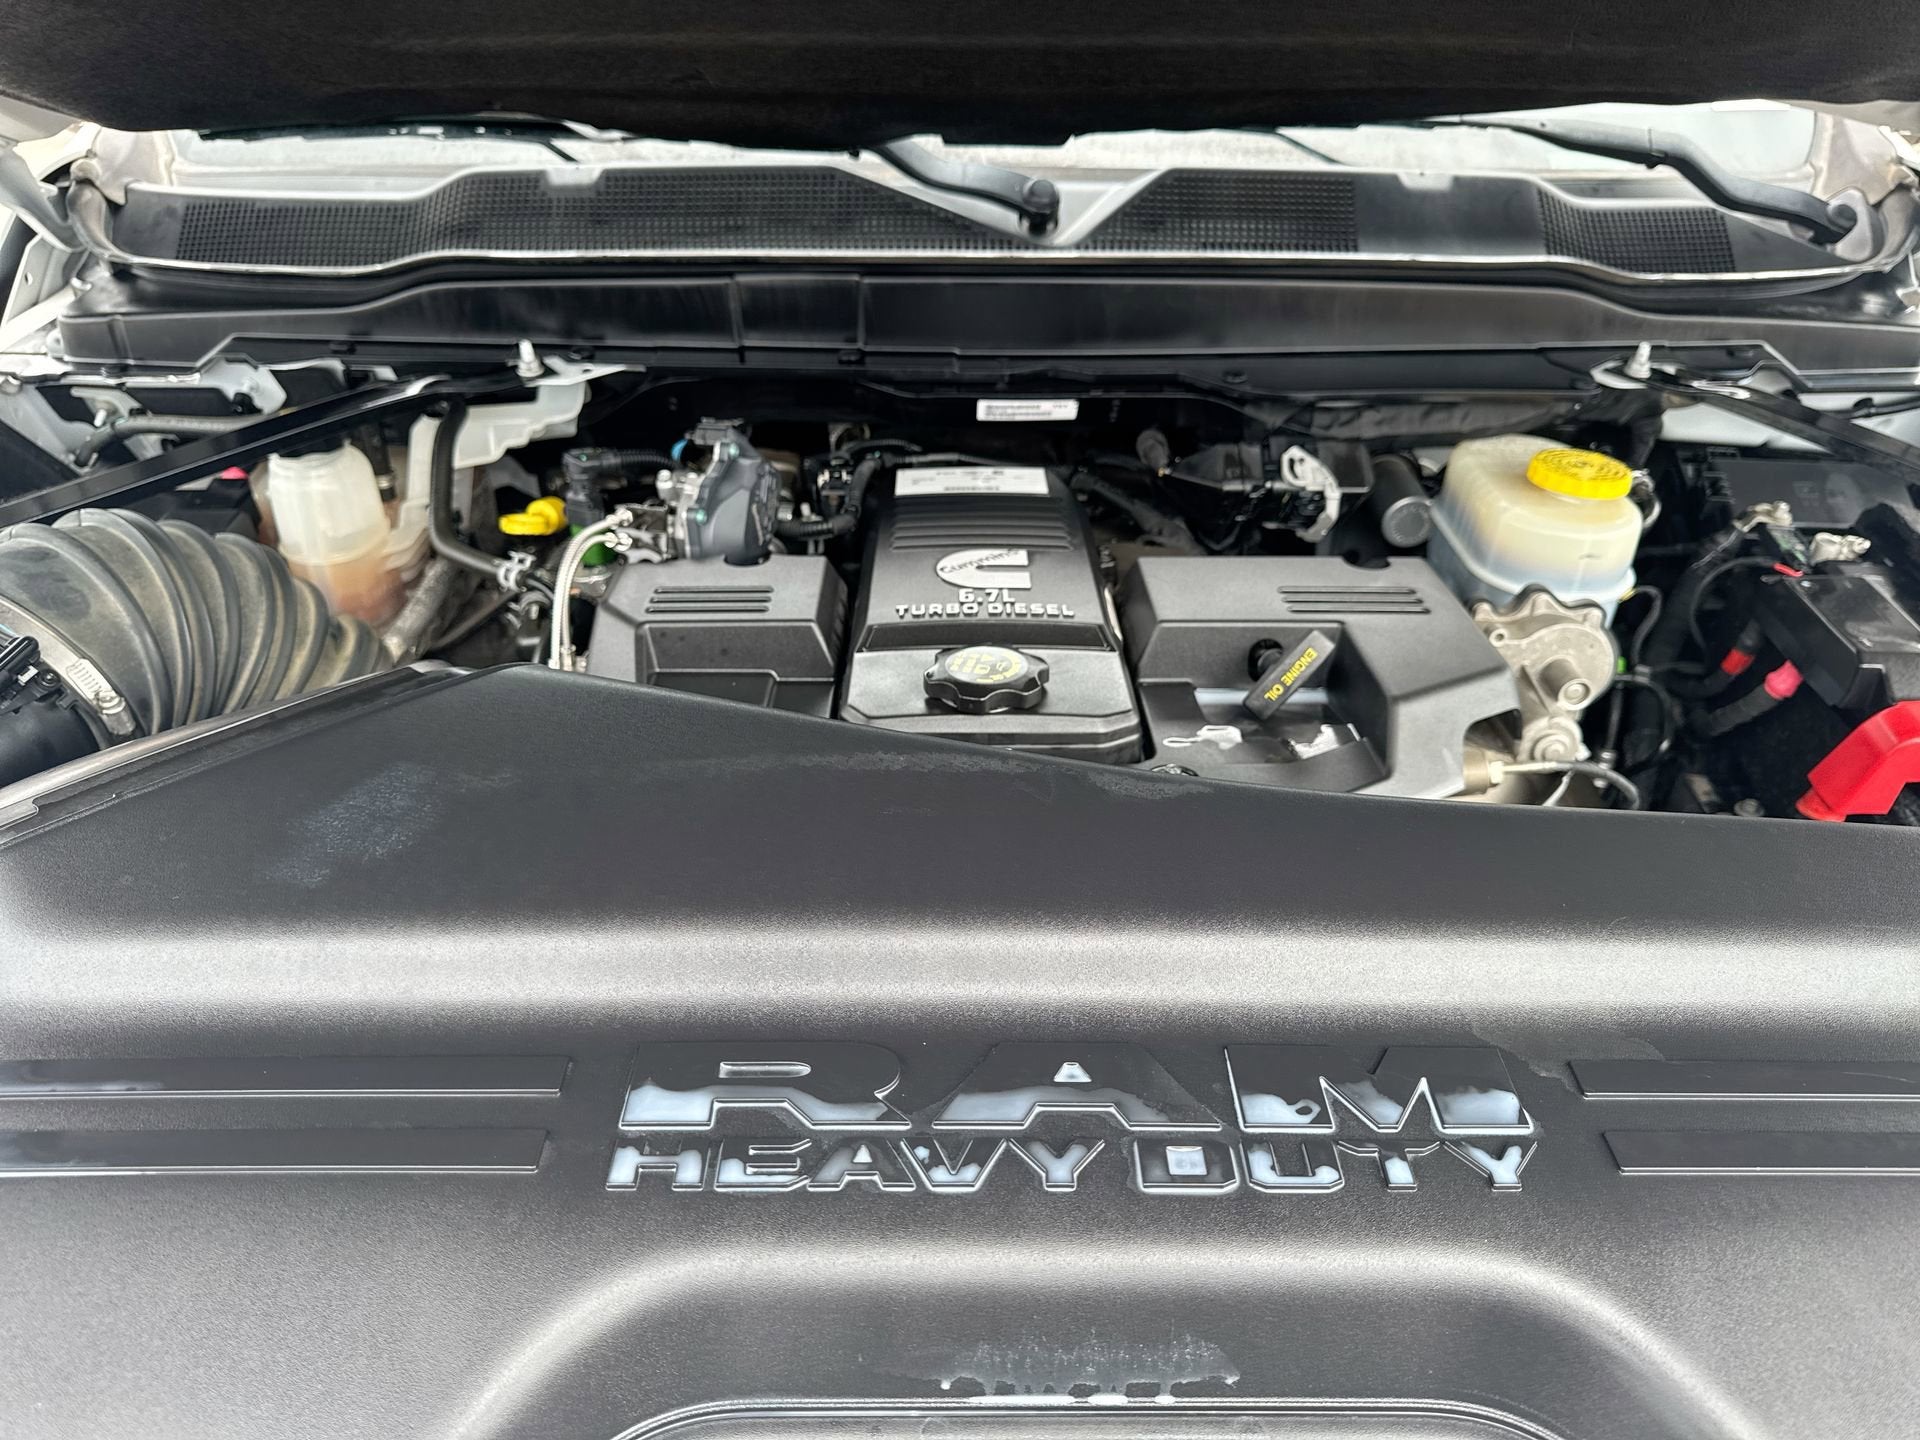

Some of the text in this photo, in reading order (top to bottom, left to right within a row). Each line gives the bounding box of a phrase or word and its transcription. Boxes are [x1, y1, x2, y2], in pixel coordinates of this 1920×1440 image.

[895, 602, 1075, 619] TURBO DIESEL
[958, 588, 1015, 603] 6.7L
[1263, 647, 1318, 702] ENGINE OIL
[618, 1040, 1535, 1135] RAM
[604, 1136, 1538, 1194] HEAVY DUTY
